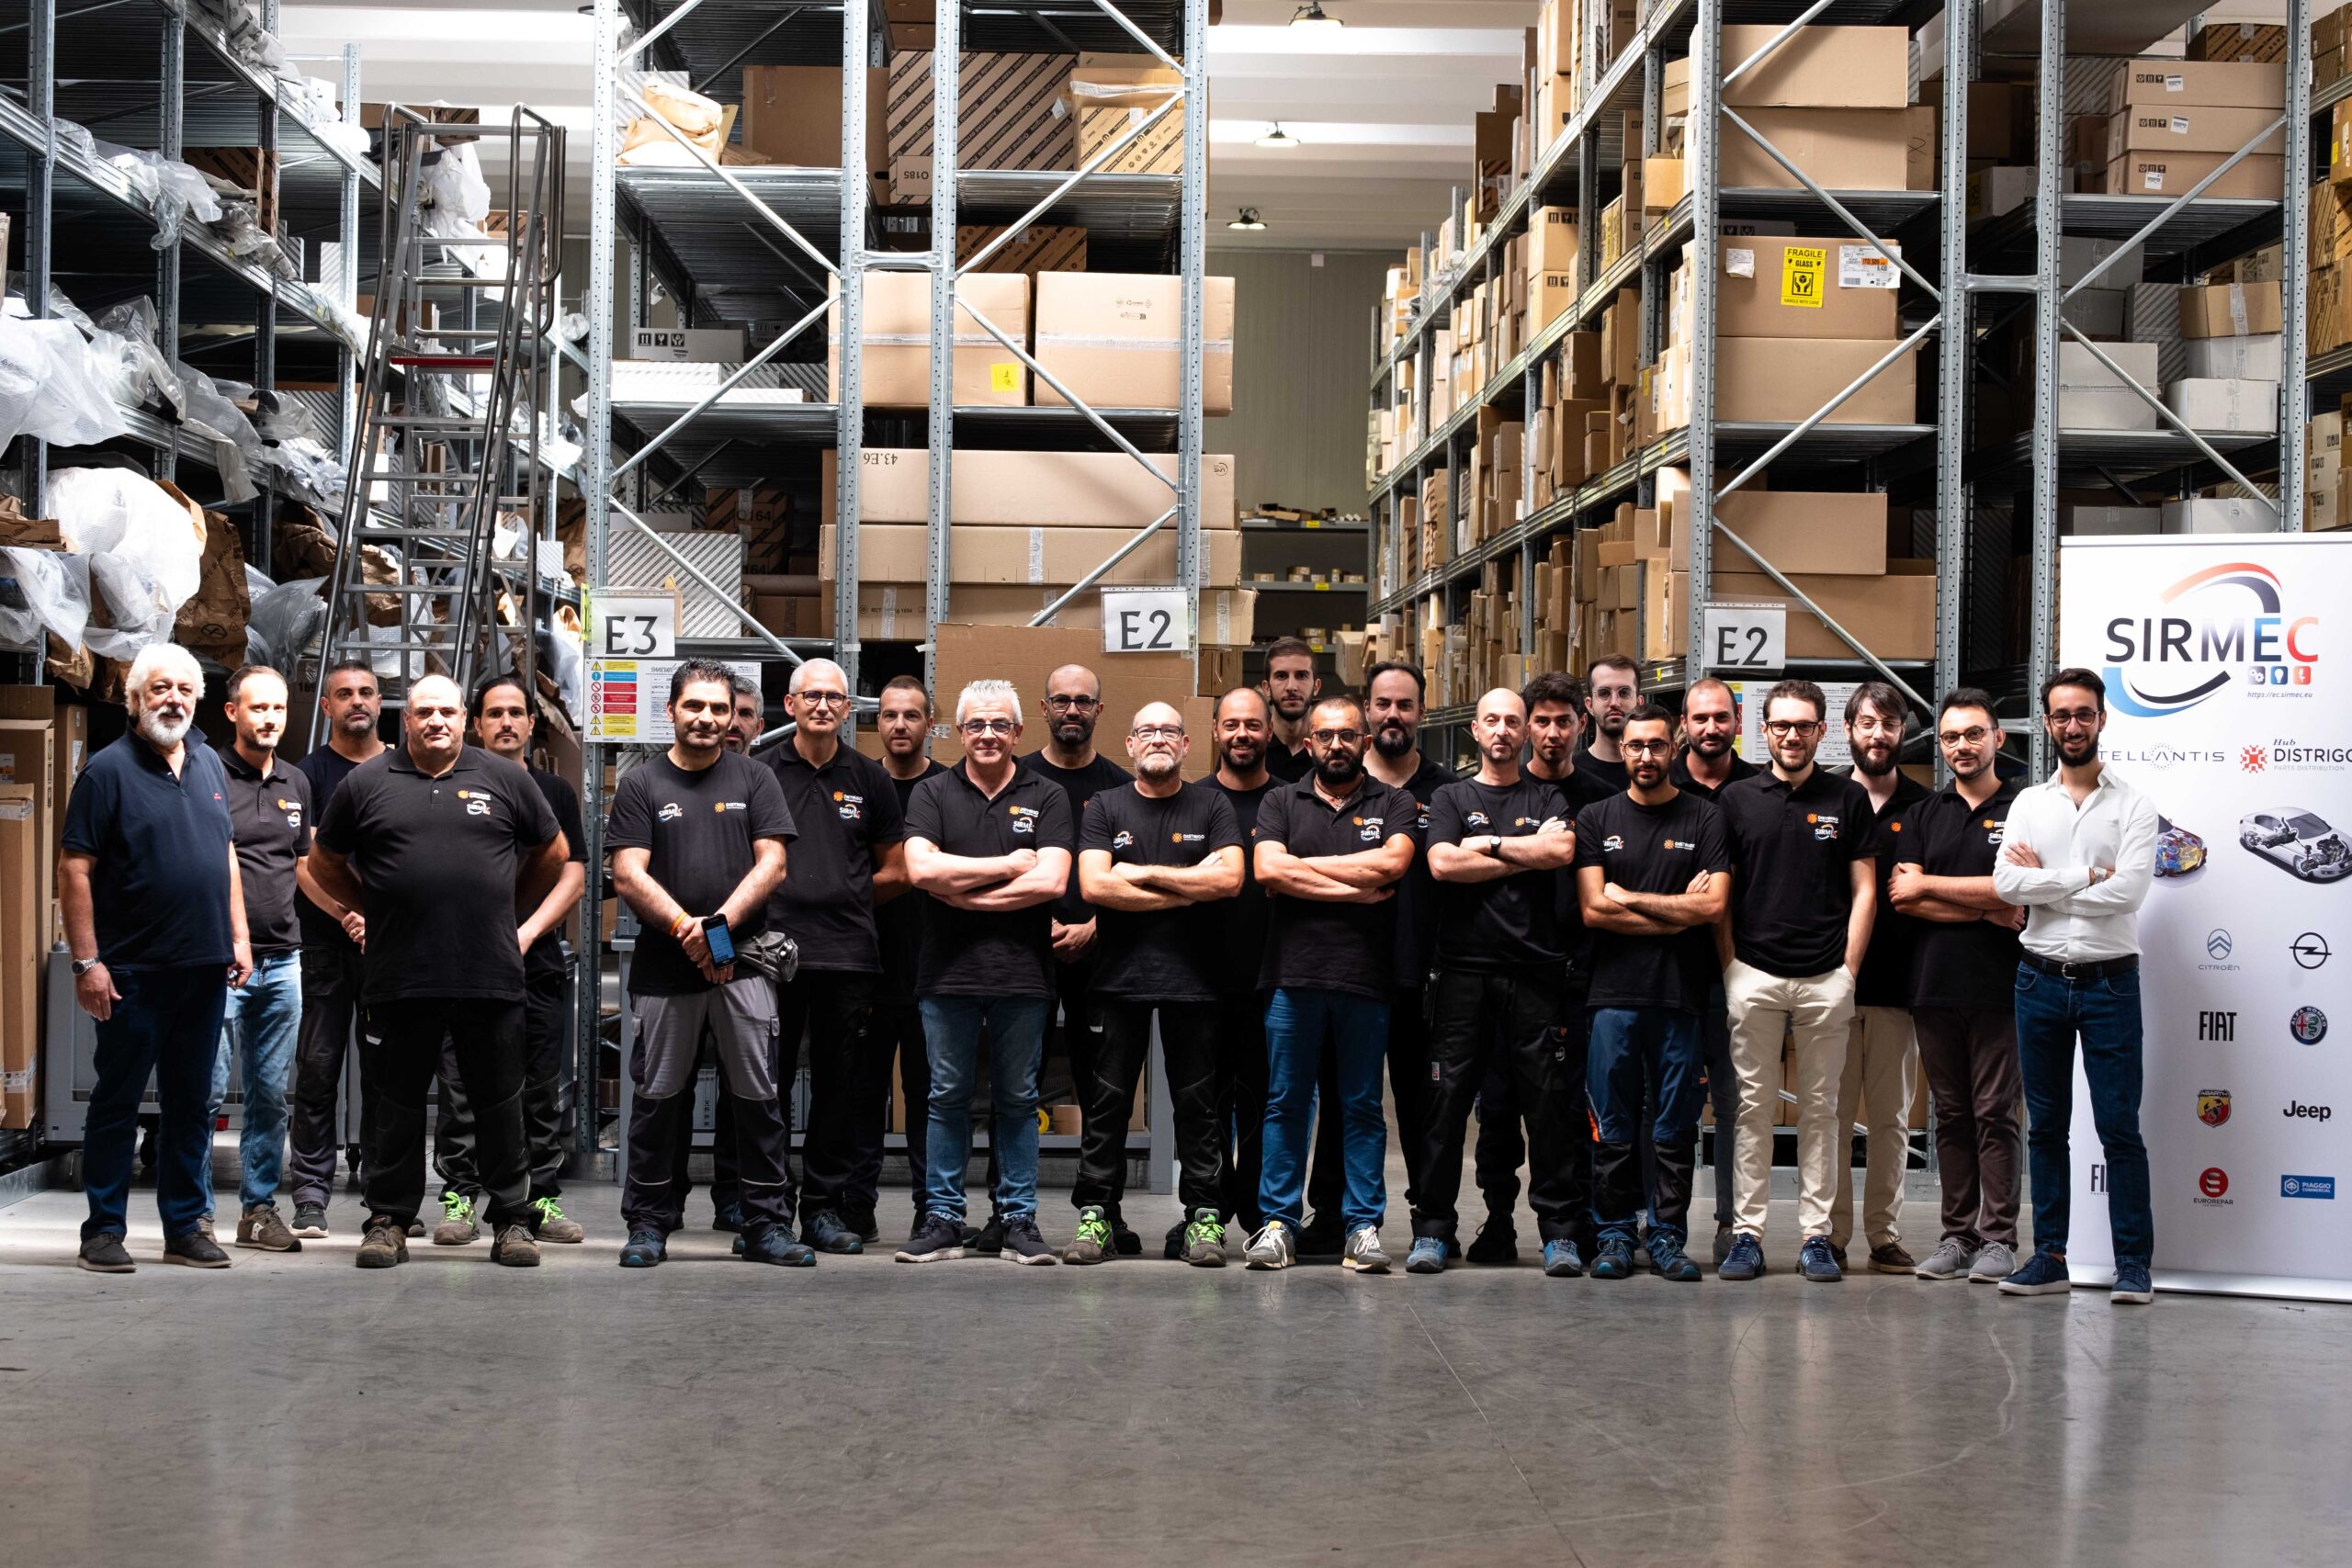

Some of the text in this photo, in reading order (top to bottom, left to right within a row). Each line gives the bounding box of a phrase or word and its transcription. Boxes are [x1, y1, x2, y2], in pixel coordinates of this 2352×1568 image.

[1787, 249, 1822, 258] FRAGILE
[1795, 260, 1813, 268] GLASS
[864, 453, 898, 465] 43.E6
[605, 616, 658, 655] E3
[1120, 610, 1172, 649] E2
[2106, 616, 2319, 662] SIRMEC
[1717, 626, 1768, 666] E2
[2098, 750, 2224, 761] TELLANTIS
[2199, 1011, 2237, 1042] FIAT
[2283, 1100, 2331, 1122] Jeep
[2193, 1197, 2233, 1205] EUROREPAR
